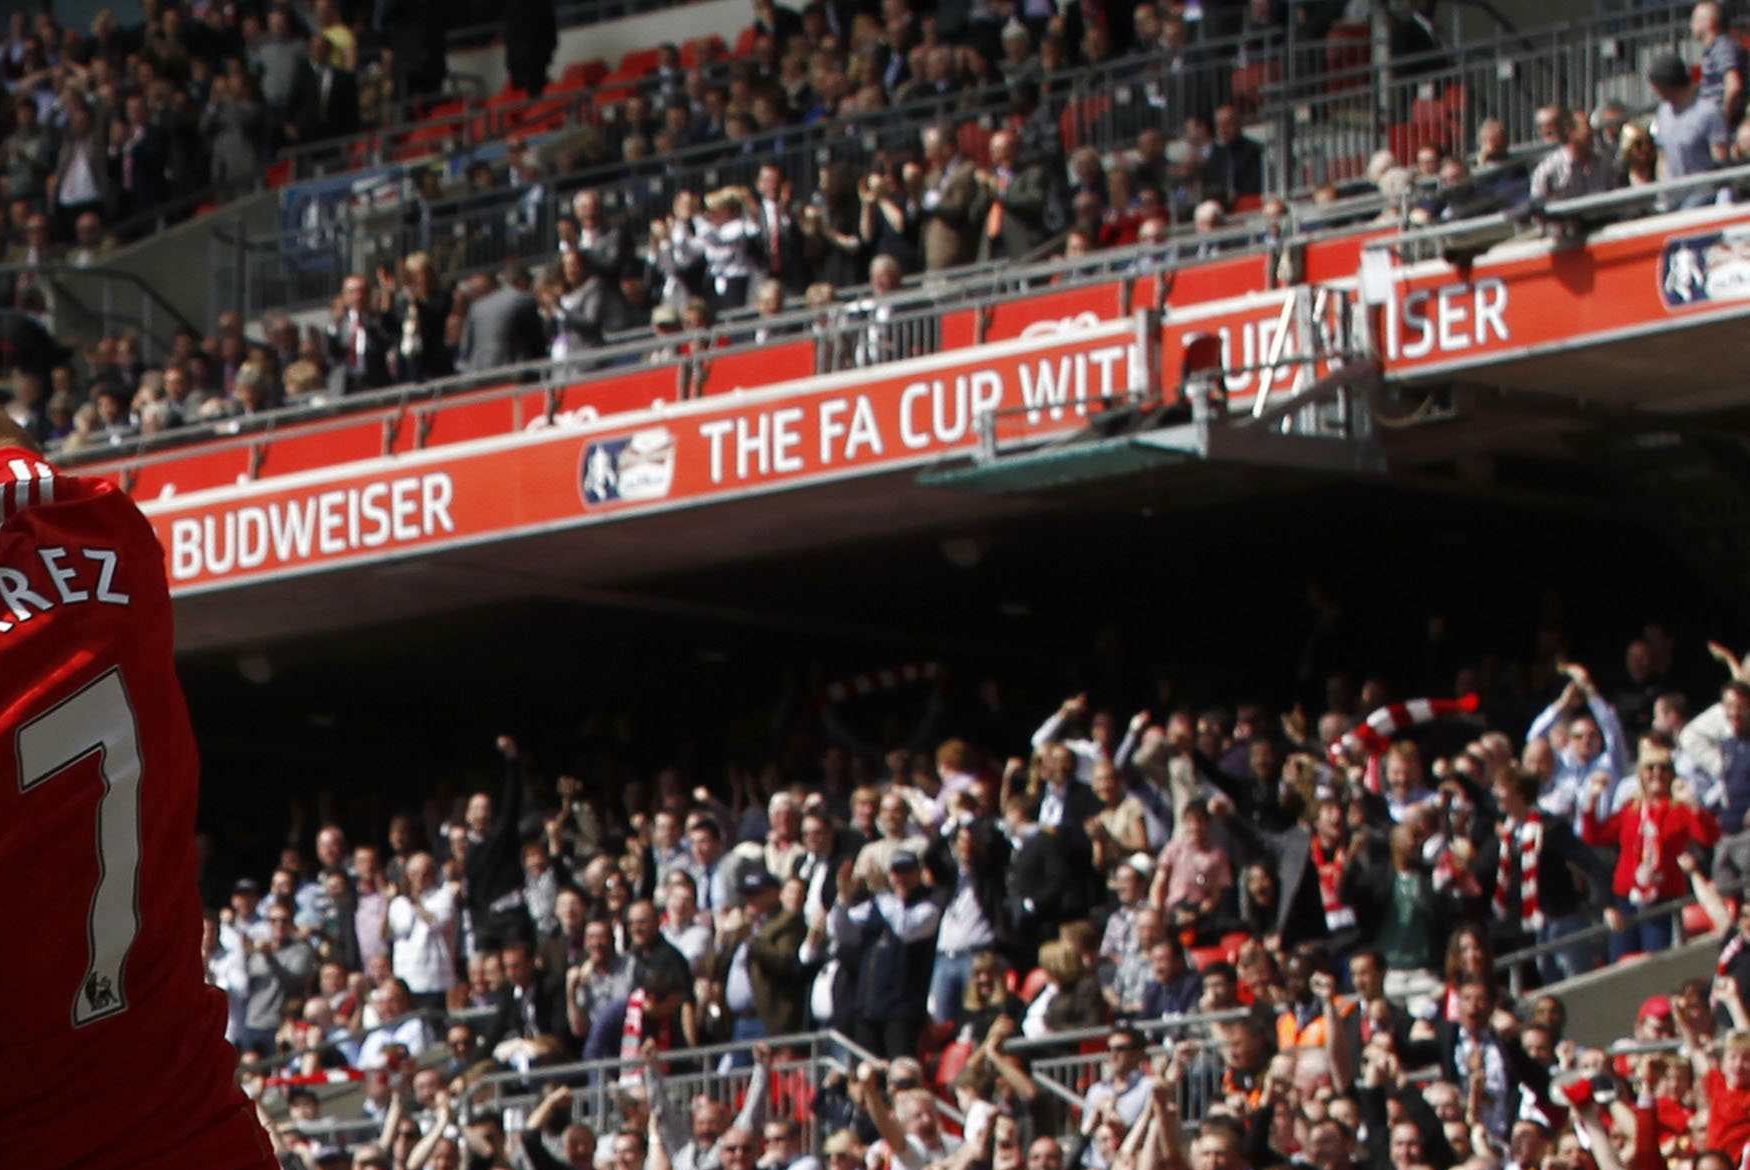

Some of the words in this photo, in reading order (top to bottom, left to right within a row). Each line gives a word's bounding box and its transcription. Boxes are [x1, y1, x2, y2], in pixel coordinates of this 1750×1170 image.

[699, 407, 804, 484] THE
[819, 394, 884, 464] FA
[899, 370, 1004, 450] CUP
[171, 471, 455, 580] BUDWEISER
[15, 664, 143, 1028] 7
